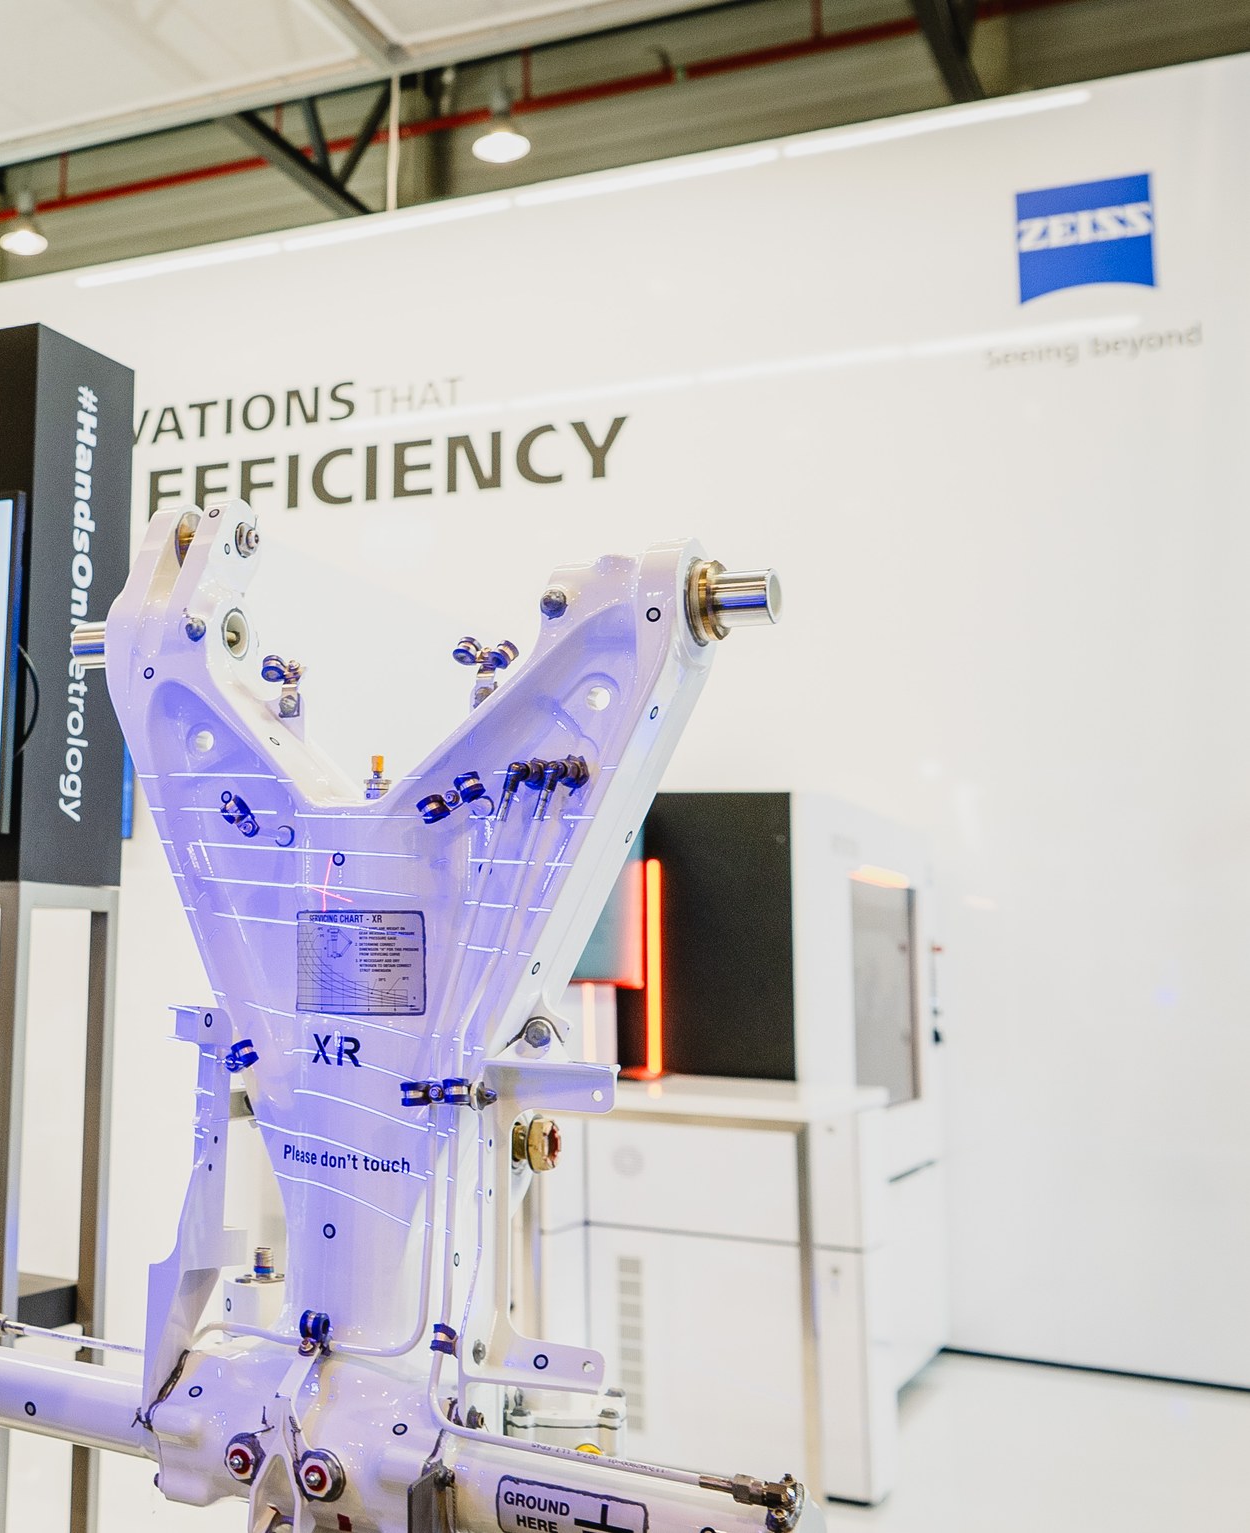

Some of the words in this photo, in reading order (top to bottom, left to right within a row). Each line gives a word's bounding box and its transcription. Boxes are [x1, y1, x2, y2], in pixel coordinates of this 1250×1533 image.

[1016, 201, 1154, 253] ZEISS
[985, 341, 1079, 369] Seeing
[1088, 322, 1203, 359] beyond
[368, 377, 464, 416] THAT
[149, 416, 628, 522] EFFICIENCY
[59, 385, 99, 823] #HandsOnetrology
[309, 914, 338, 923] SERVICING
[339, 915, 364, 923] CHART
[372, 915, 383, 923] XR
[312, 1033, 361, 1067] XR
[283, 1144, 317, 1164] Please
[320, 1151, 358, 1170] don't
[363, 1156, 410, 1173] touch
[503, 1491, 570, 1517] GROUND
[516, 1514, 558, 1533] HERE
